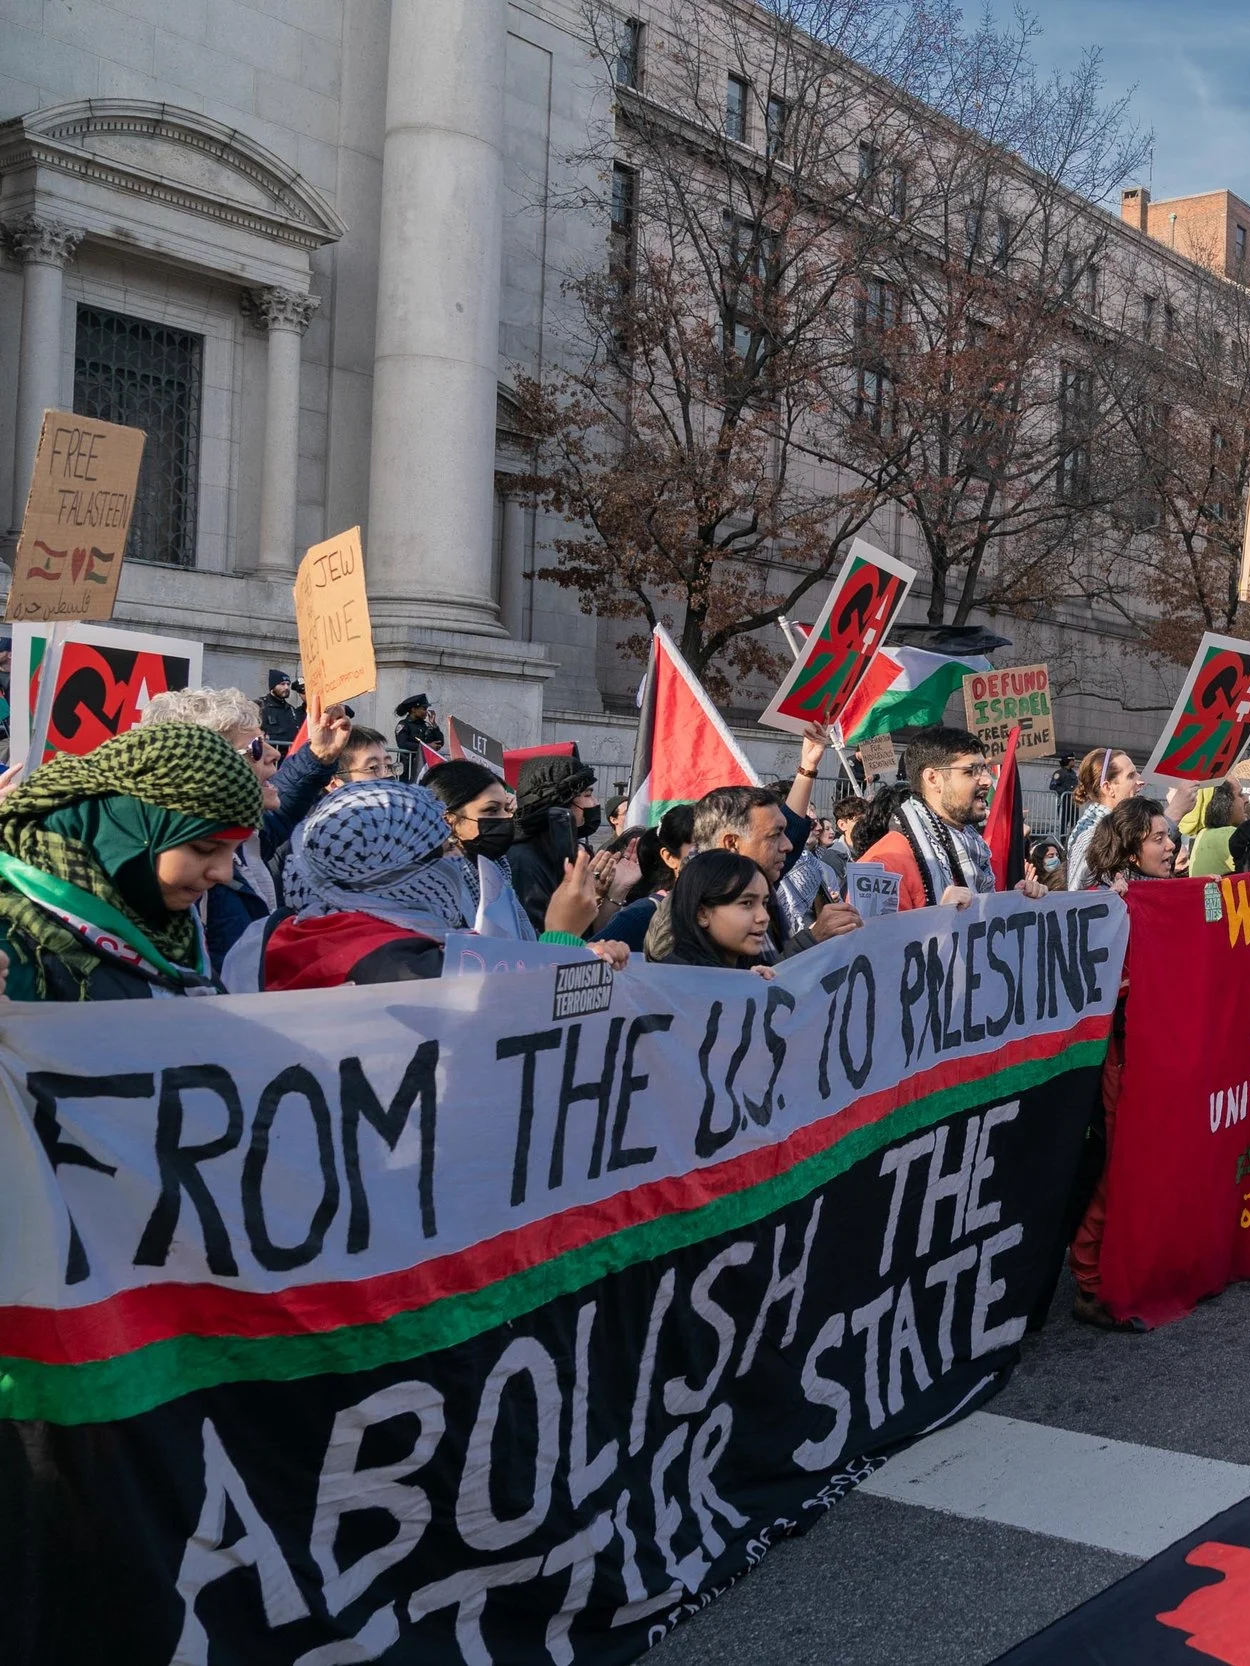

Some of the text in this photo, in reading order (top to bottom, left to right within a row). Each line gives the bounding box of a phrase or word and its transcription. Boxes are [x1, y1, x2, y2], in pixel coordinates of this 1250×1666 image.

[50, 428, 107, 481] FREE
[58, 489, 131, 530] FALASTEEN
[313, 545, 355, 588] JEW
[971, 669, 1049, 701] DEFUND
[974, 691, 1051, 725] ISRAEL
[472, 733, 488, 756] LET
[556, 962, 612, 993] ZIONISM IS
[555, 985, 612, 1017] TERRORISM
[26, 1039, 439, 1286] FROM
[496, 1013, 675, 1208] THE
[818, 954, 876, 1100] TO
[900, 904, 1110, 1070] PALESTINE
[792, 1223, 1029, 1471] STATE
[169, 1195, 826, 1666] ABOLISH
[879, 1099, 1021, 1277] THE
